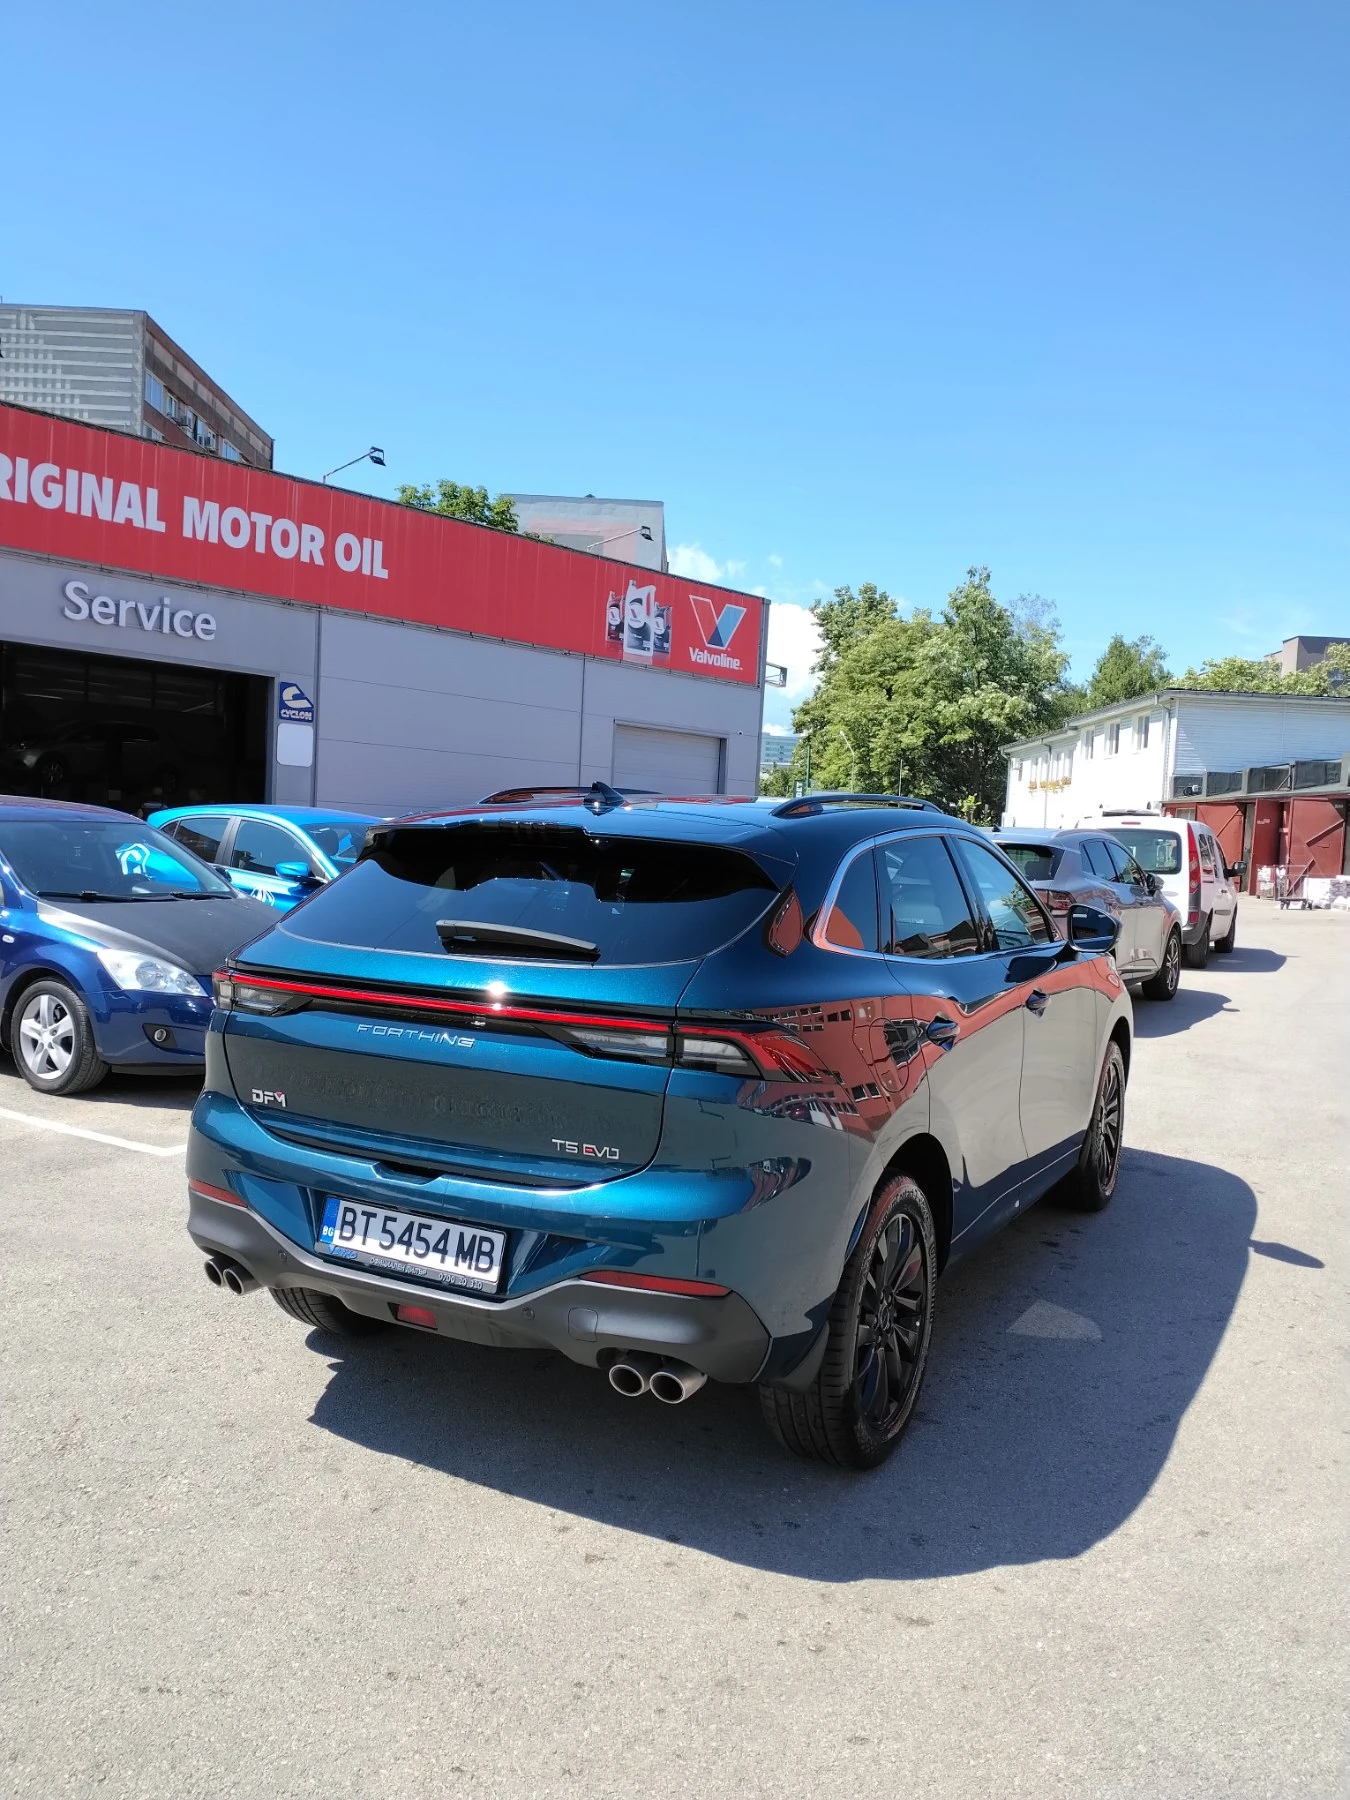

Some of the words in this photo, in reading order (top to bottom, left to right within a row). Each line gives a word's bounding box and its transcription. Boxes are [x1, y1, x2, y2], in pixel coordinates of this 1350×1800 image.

[182, 495, 325, 567] MOTOR
[334, 532, 389, 579] OIL
[63, 580, 217, 641] Service
[689, 646, 741, 670] Valvoline
[280, 708, 313, 721] CYCLON
[356, 1023, 476, 1049] FORTHING
[551, 1138, 579, 1154] T5
[582, 1143, 620, 1160] EVO
[321, 1225, 335, 1237] BG
[439, 1272, 456, 1284] 0700
[458, 1277, 468, 1287] 20
